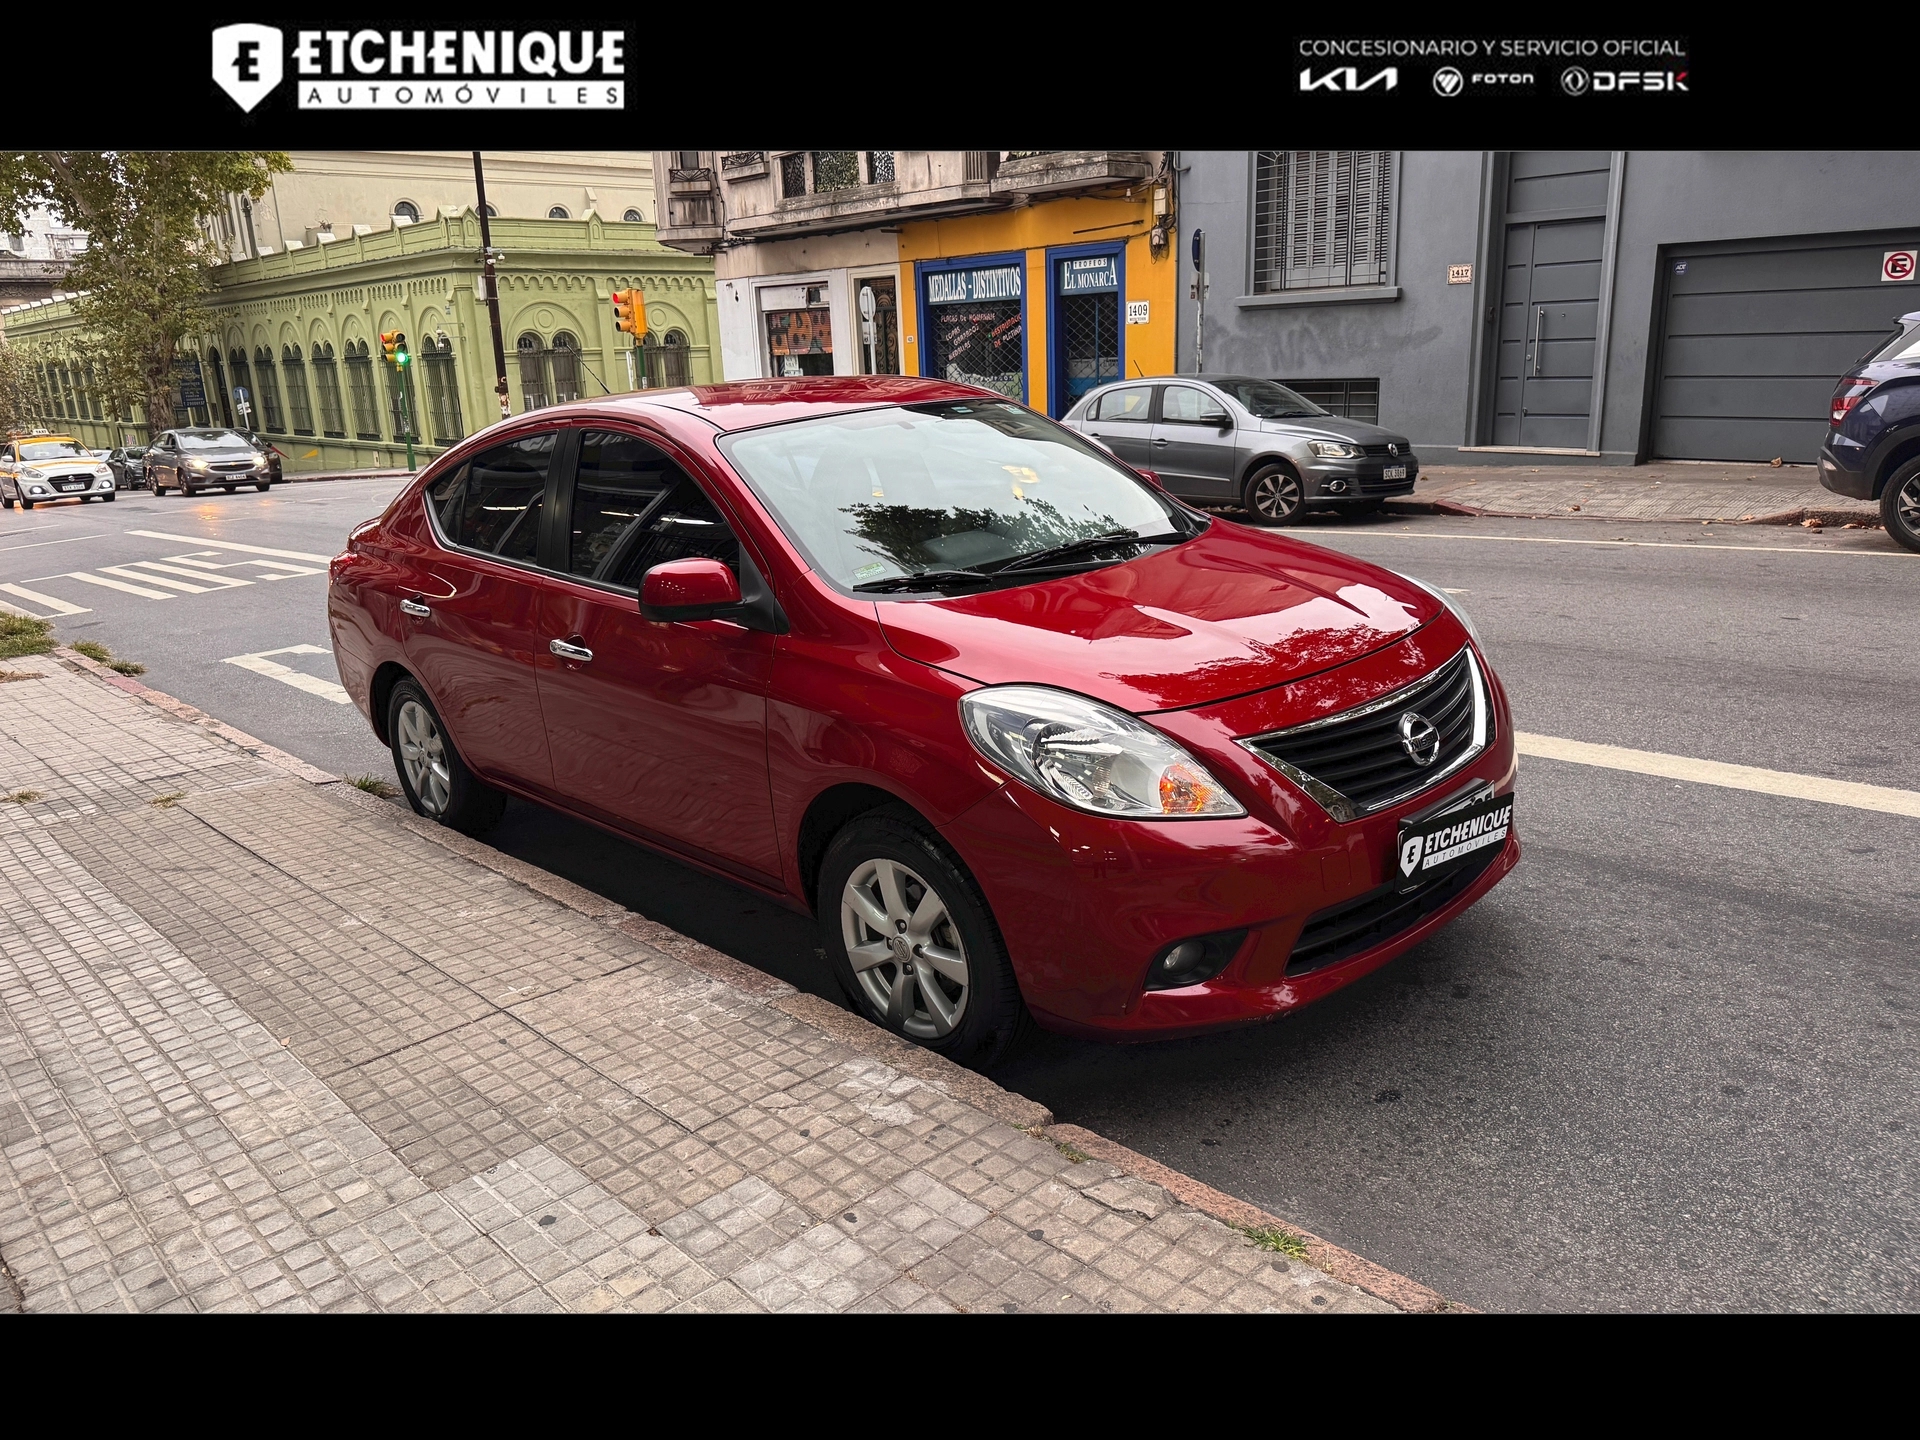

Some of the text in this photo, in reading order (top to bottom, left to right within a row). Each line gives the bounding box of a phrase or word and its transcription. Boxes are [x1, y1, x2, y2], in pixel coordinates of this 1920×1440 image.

[1064, 257, 1118, 289] EL MONARCA
[1074, 259, 1107, 268] TROFEOS
[928, 272, 966, 302] MEDALLAS
[972, 267, 1021, 299] DISTINTIVOS
[1129, 304, 1147, 316] 1409
[1424, 804, 1512, 855] ETCHENIQUE
